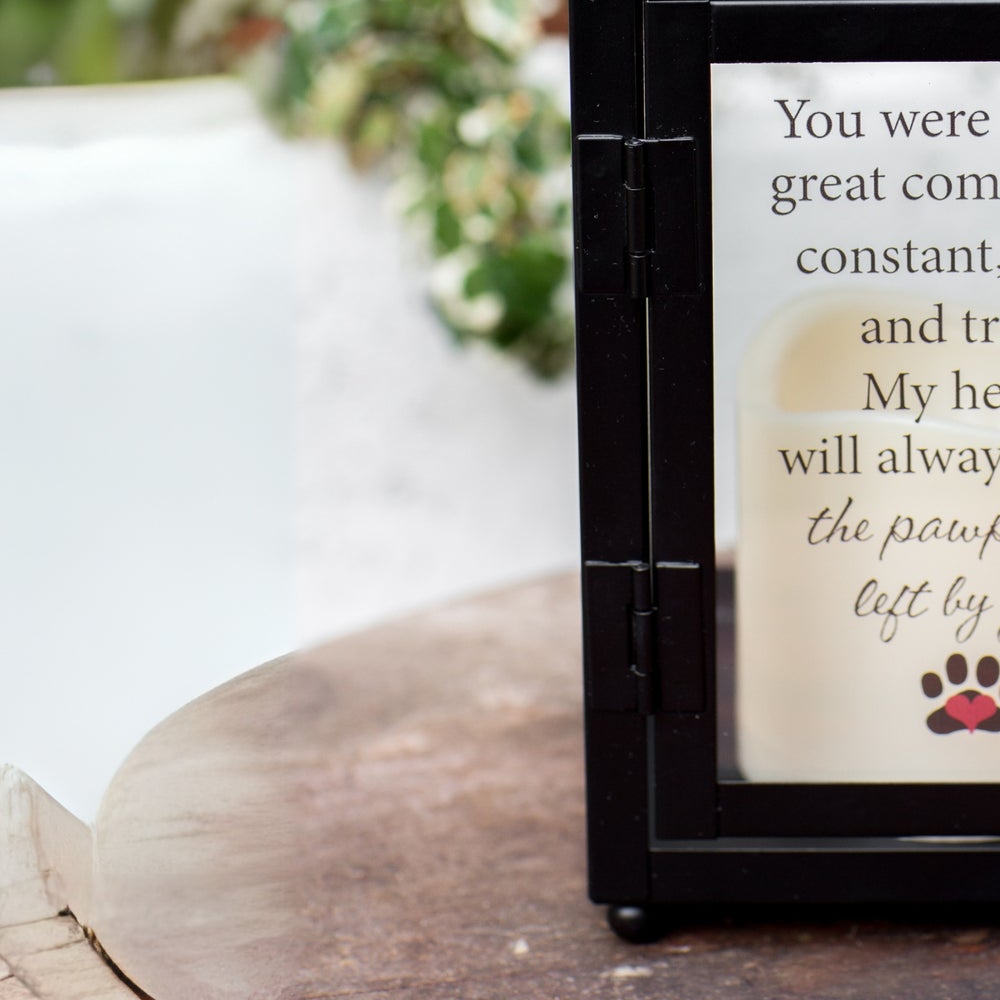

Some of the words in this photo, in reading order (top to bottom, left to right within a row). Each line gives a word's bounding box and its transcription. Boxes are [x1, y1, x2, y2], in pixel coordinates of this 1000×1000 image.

[774, 100, 865, 138] You
[880, 110, 989, 137] were
[771, 167, 886, 216] great
[861, 303, 947, 344] and
[862, 373, 937, 423] My
[778, 435, 861, 474] will
[808, 497, 873, 545] the
[854, 579, 932, 643] left
[943, 576, 992, 643] by
